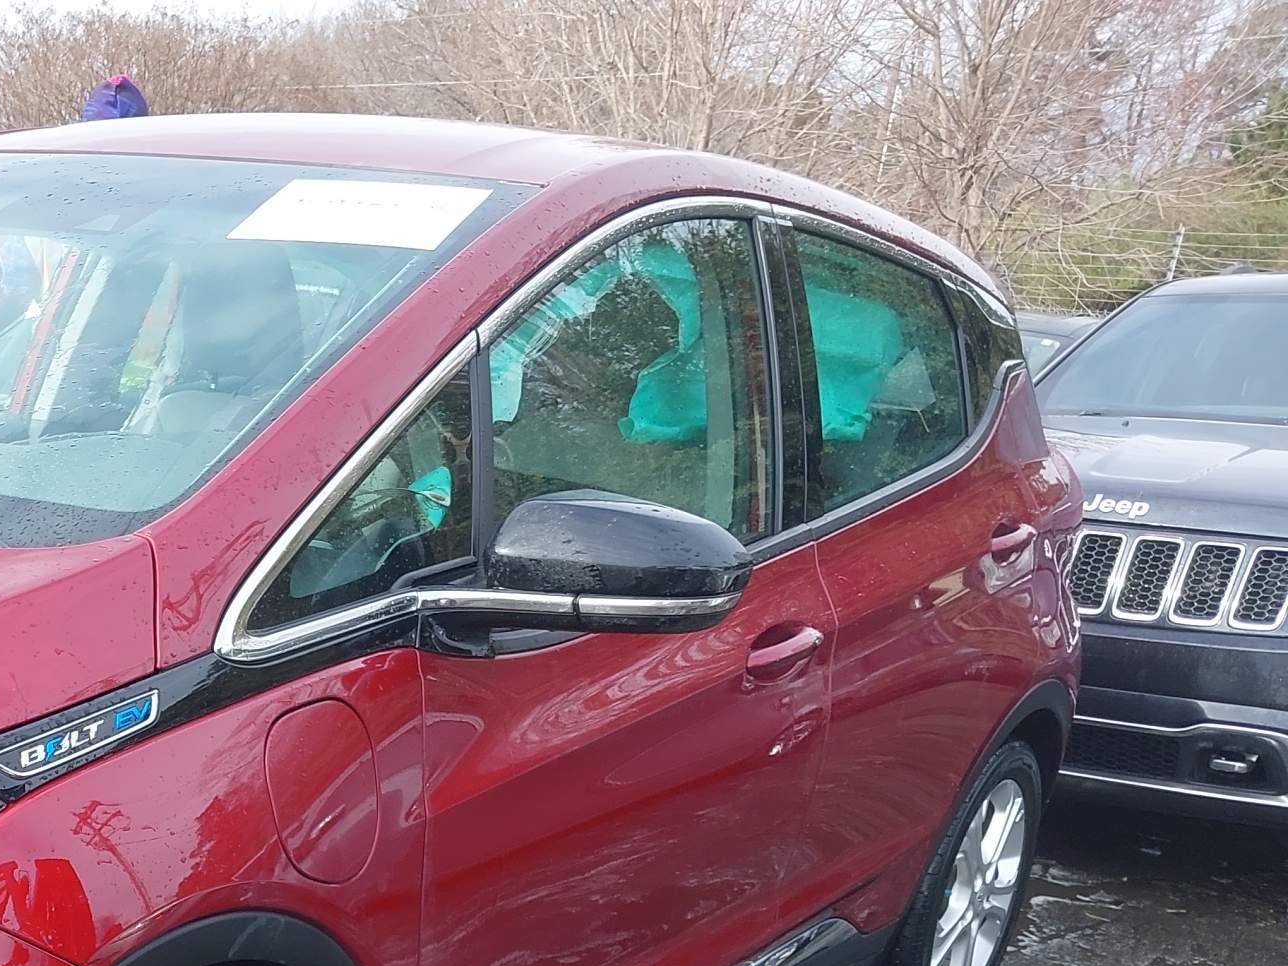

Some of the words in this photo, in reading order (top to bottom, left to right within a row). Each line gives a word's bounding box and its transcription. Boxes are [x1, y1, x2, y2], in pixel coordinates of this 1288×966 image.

[1082, 493, 1150, 519] Jeep
[19, 719, 104, 768] BOLT
[113, 699, 151, 730] EV
